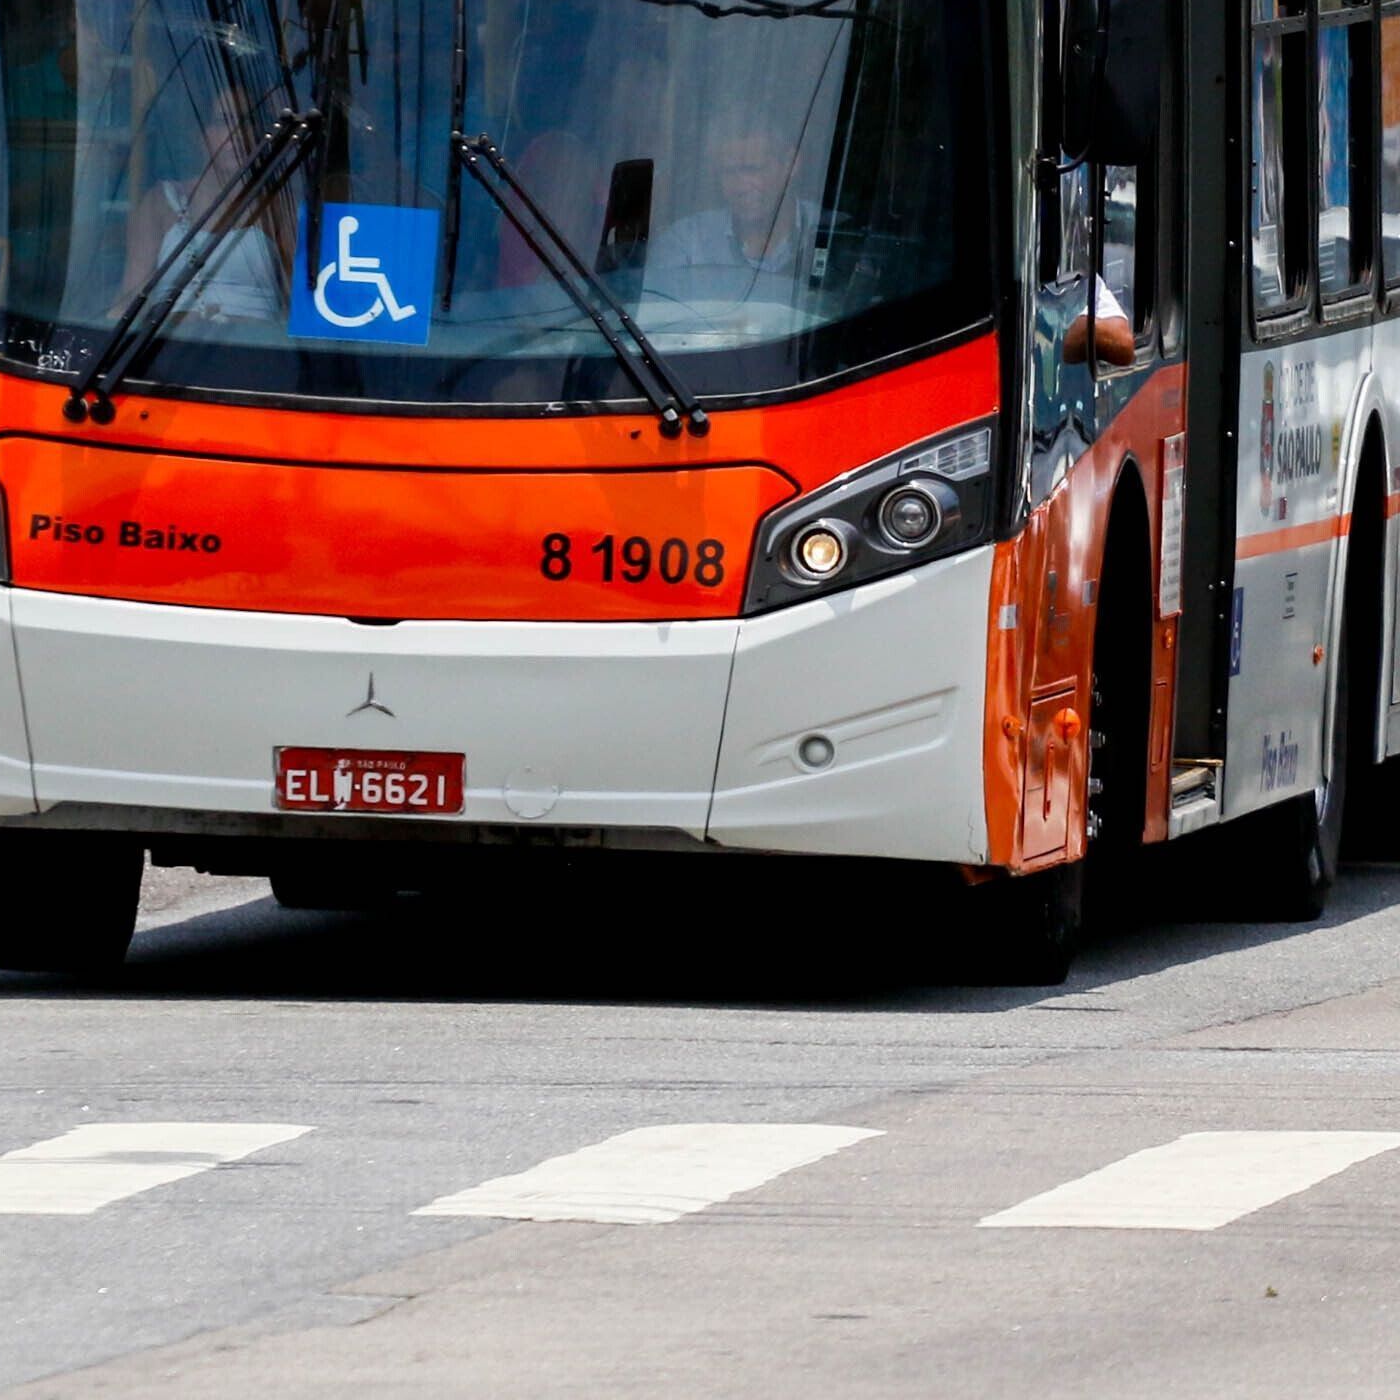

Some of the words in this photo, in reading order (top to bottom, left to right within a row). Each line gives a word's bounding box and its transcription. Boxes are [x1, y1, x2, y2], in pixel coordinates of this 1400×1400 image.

[30, 514, 104, 545] Piso
[119, 521, 222, 553] Baixo
[540, 533, 572, 582] 8
[591, 535, 725, 588] 1908
